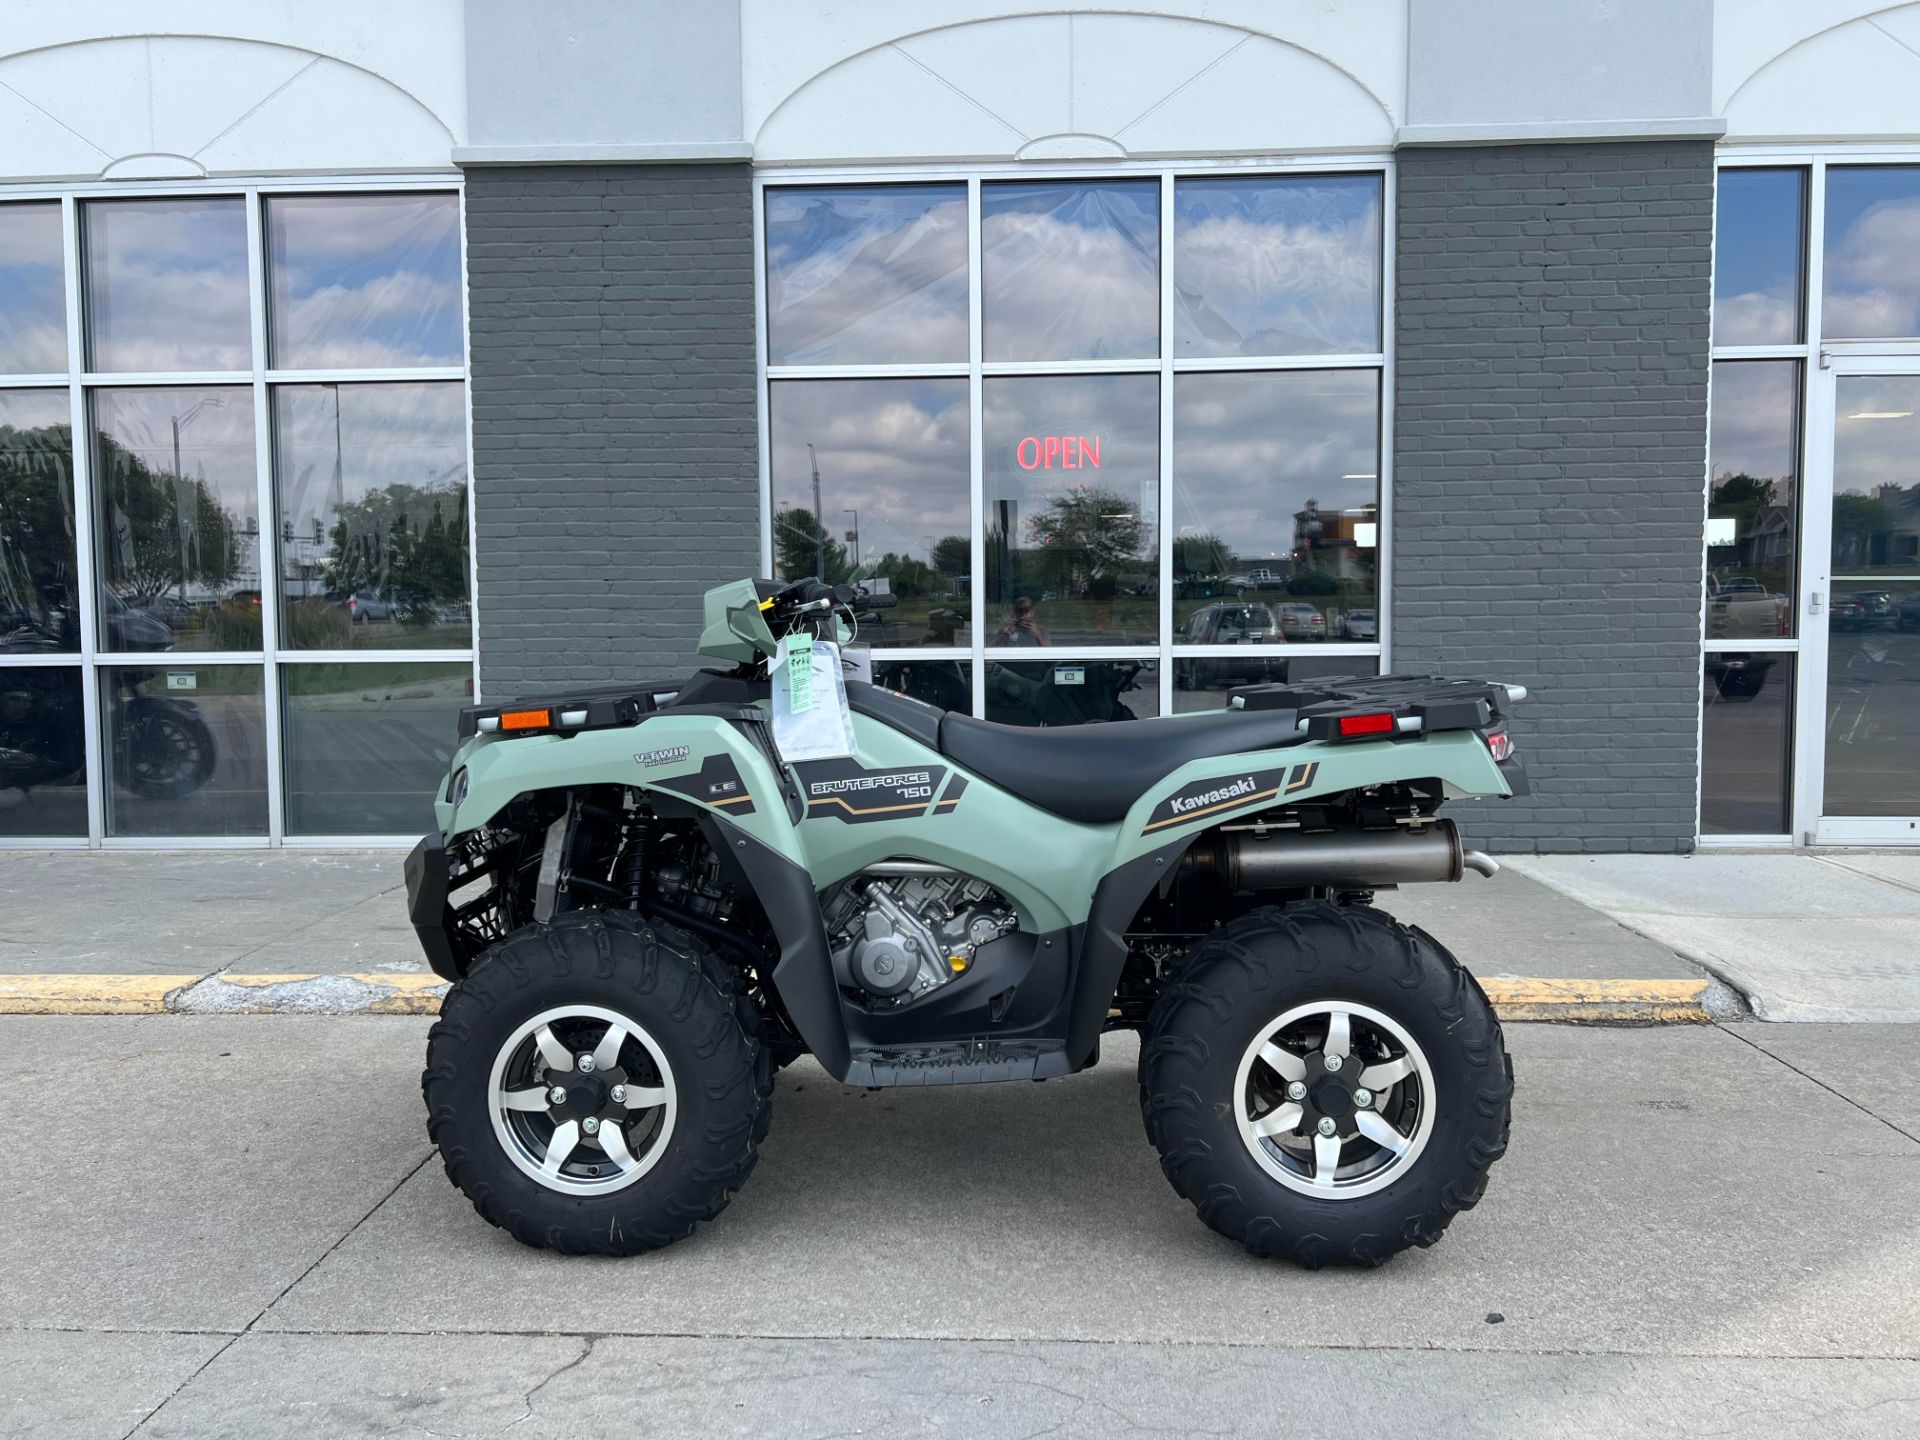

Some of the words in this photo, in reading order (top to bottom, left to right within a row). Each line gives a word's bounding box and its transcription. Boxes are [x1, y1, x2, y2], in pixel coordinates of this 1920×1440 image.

[1017, 436, 1100, 471] OPEN
[634, 746, 689, 763] V-TWIN
[709, 781, 737, 795] LE
[896, 785, 932, 799] 750
[1170, 776, 1256, 814] Kawasaki
